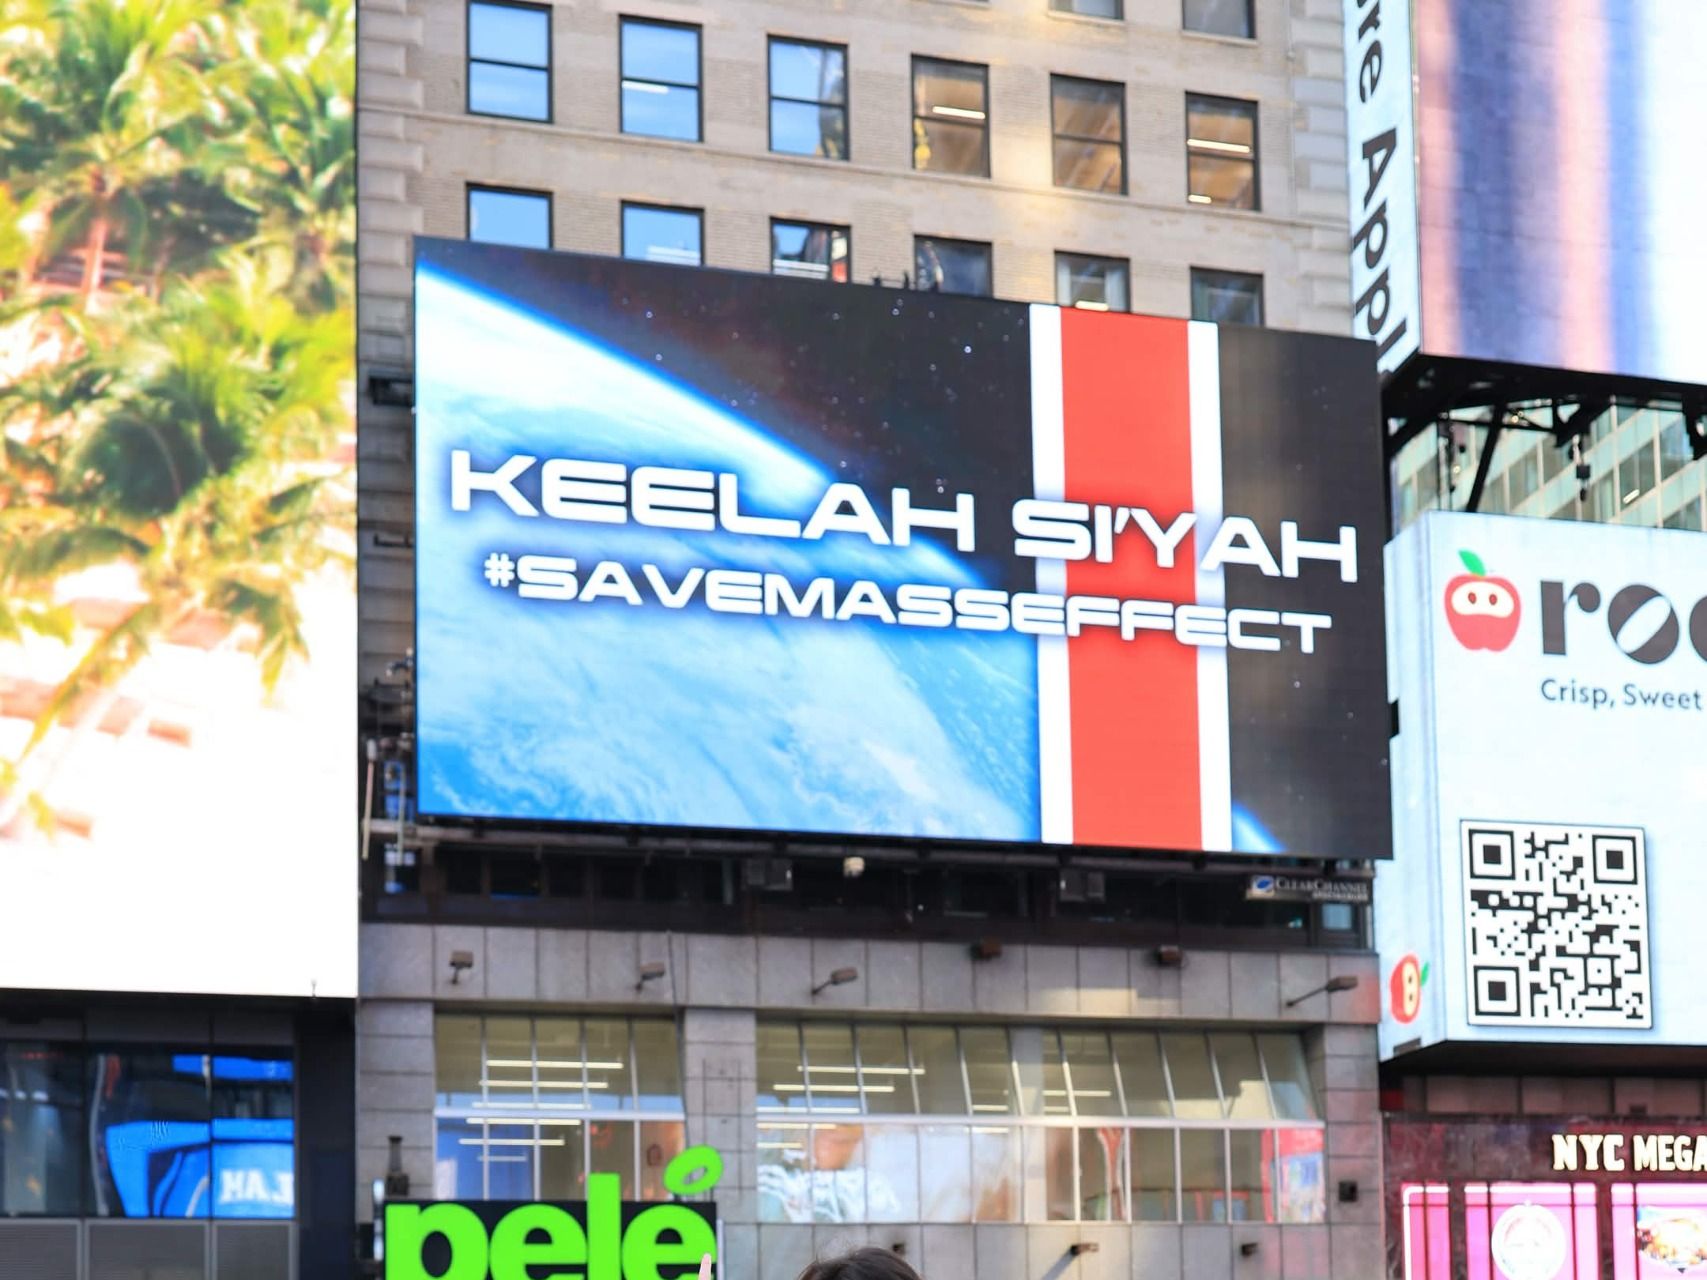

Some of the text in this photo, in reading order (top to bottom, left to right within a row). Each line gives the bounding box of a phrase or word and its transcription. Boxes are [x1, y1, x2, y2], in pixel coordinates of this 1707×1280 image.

[1356, 0, 1383, 103] re
[450, 449, 1357, 583] KEELAH SI'YAH
[484, 552, 1332, 654] #SAVEMASSEFFECT
[1541, 678, 1703, 711] Crisp, Sweet
[1552, 1134, 1625, 1171] NYC
